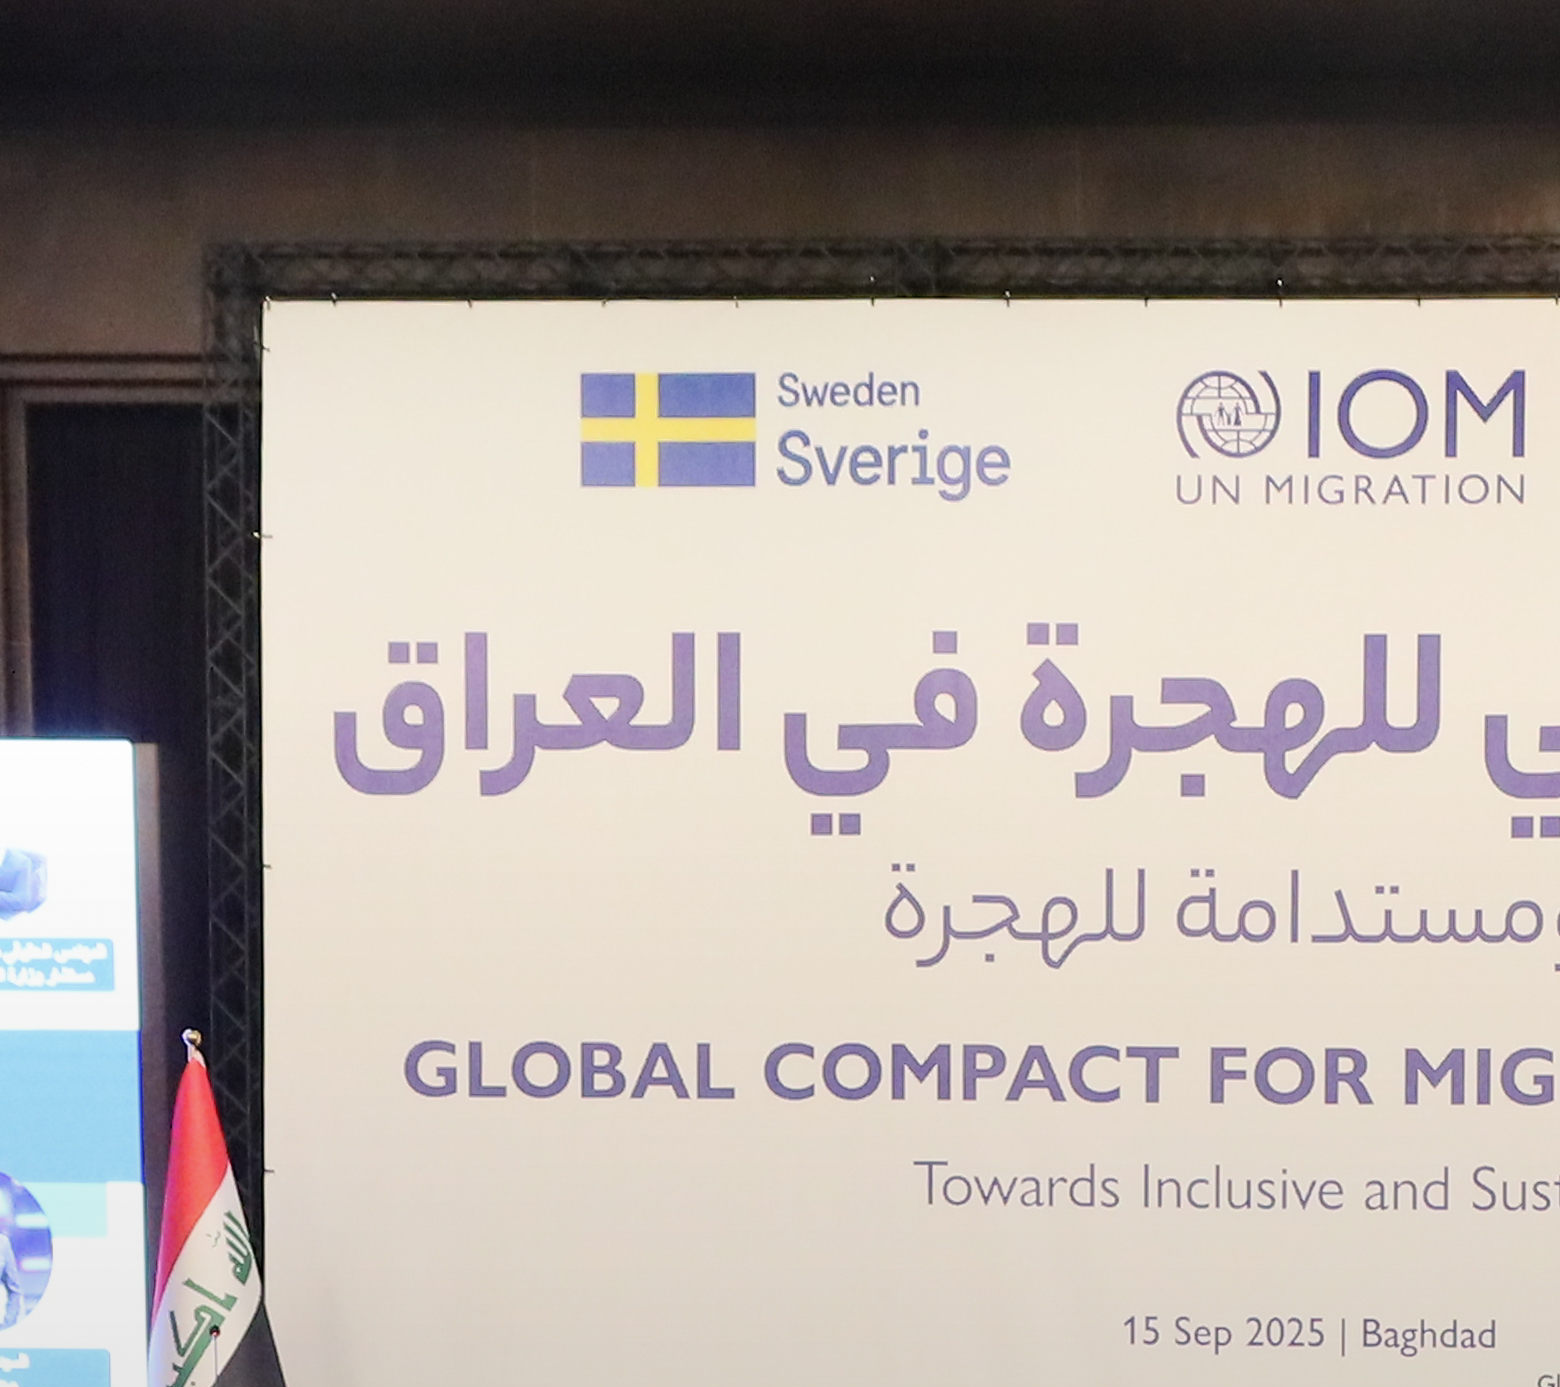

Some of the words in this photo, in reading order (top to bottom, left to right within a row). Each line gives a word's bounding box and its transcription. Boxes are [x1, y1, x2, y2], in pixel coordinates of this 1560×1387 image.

[778, 372, 919, 407] Sweden
[1308, 370, 1525, 459] IOM
[777, 429, 1010, 501] Sverige
[1177, 475, 1239, 504] UN
[1266, 474, 1524, 504] MIGRATION
[334, 632, 740, 796] العراق
[784, 631, 977, 836] في
[1020, 623, 1441, 800] للهجرة
[885, 863, 1145, 969] للهجرة
[404, 1040, 735, 1099] GLOBAL
[764, 1043, 1179, 1103] COMPACT
[1210, 1047, 1373, 1105] FOR
[914, 1161, 1119, 1207] Towards
[1144, 1164, 1343, 1210] Inclusive
[1365, 1166, 1448, 1210] and
[1124, 1316, 1159, 1345] 15
[1175, 1317, 1232, 1355] Sep
[1247, 1317, 1324, 1346] 2025
[1363, 1319, 1495, 1357] Baghdad
